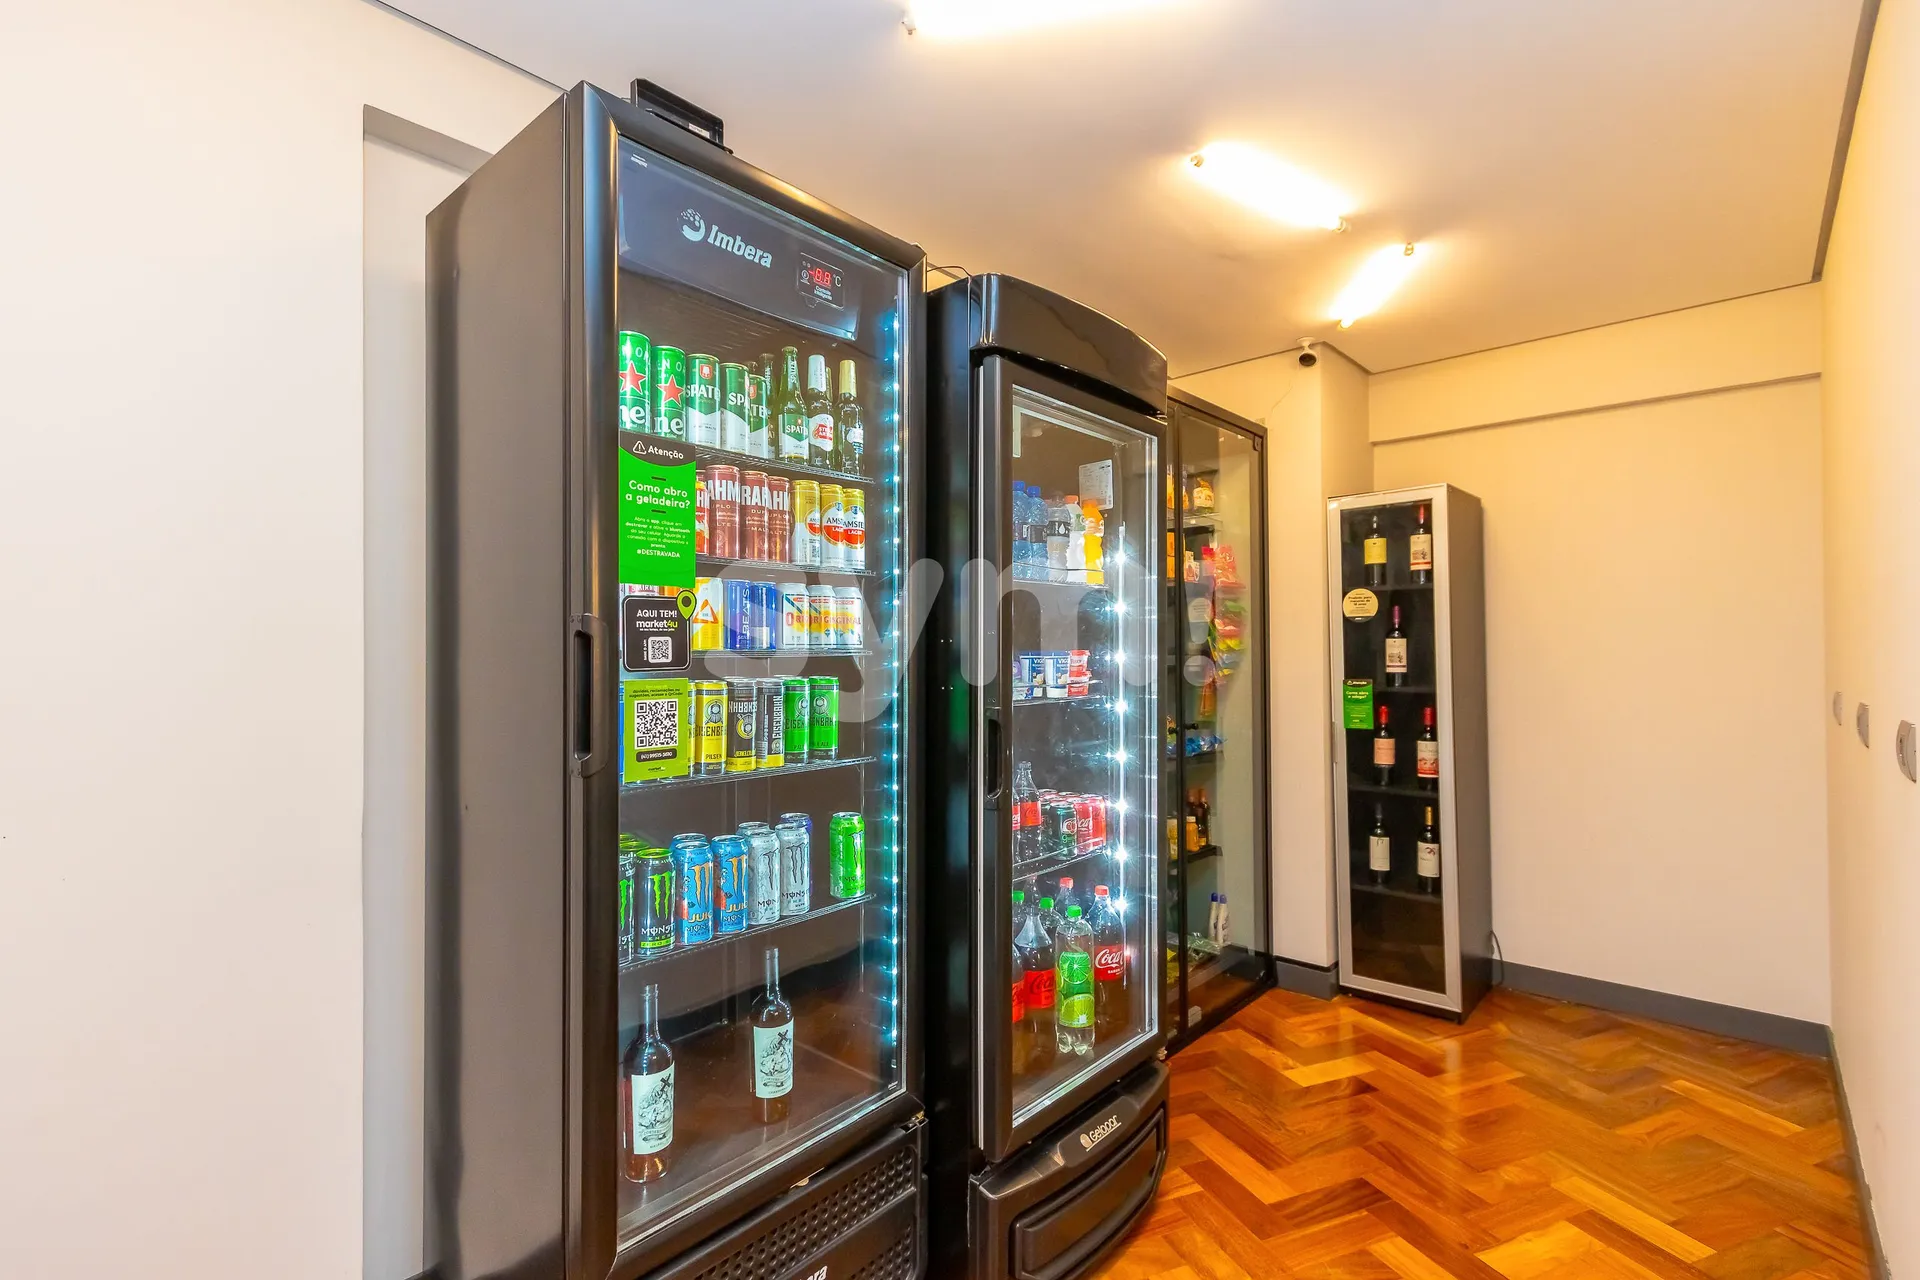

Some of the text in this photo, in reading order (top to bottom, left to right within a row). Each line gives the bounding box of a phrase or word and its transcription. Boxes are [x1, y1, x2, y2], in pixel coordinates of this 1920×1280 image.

[707, 224, 773, 269] Imbera
[648, 444, 685, 460] Atenção
[628, 479, 688, 499] Como abro
[625, 493, 691, 510] a geladeira?
[636, 609, 677, 619] AQUI TEM!
[742, 588, 751, 634] BEATS
[636, 619, 679, 629] market4u
[772, 695, 783, 739] EISENBAHN
[1089, 1114, 1118, 1142] Gelopar
